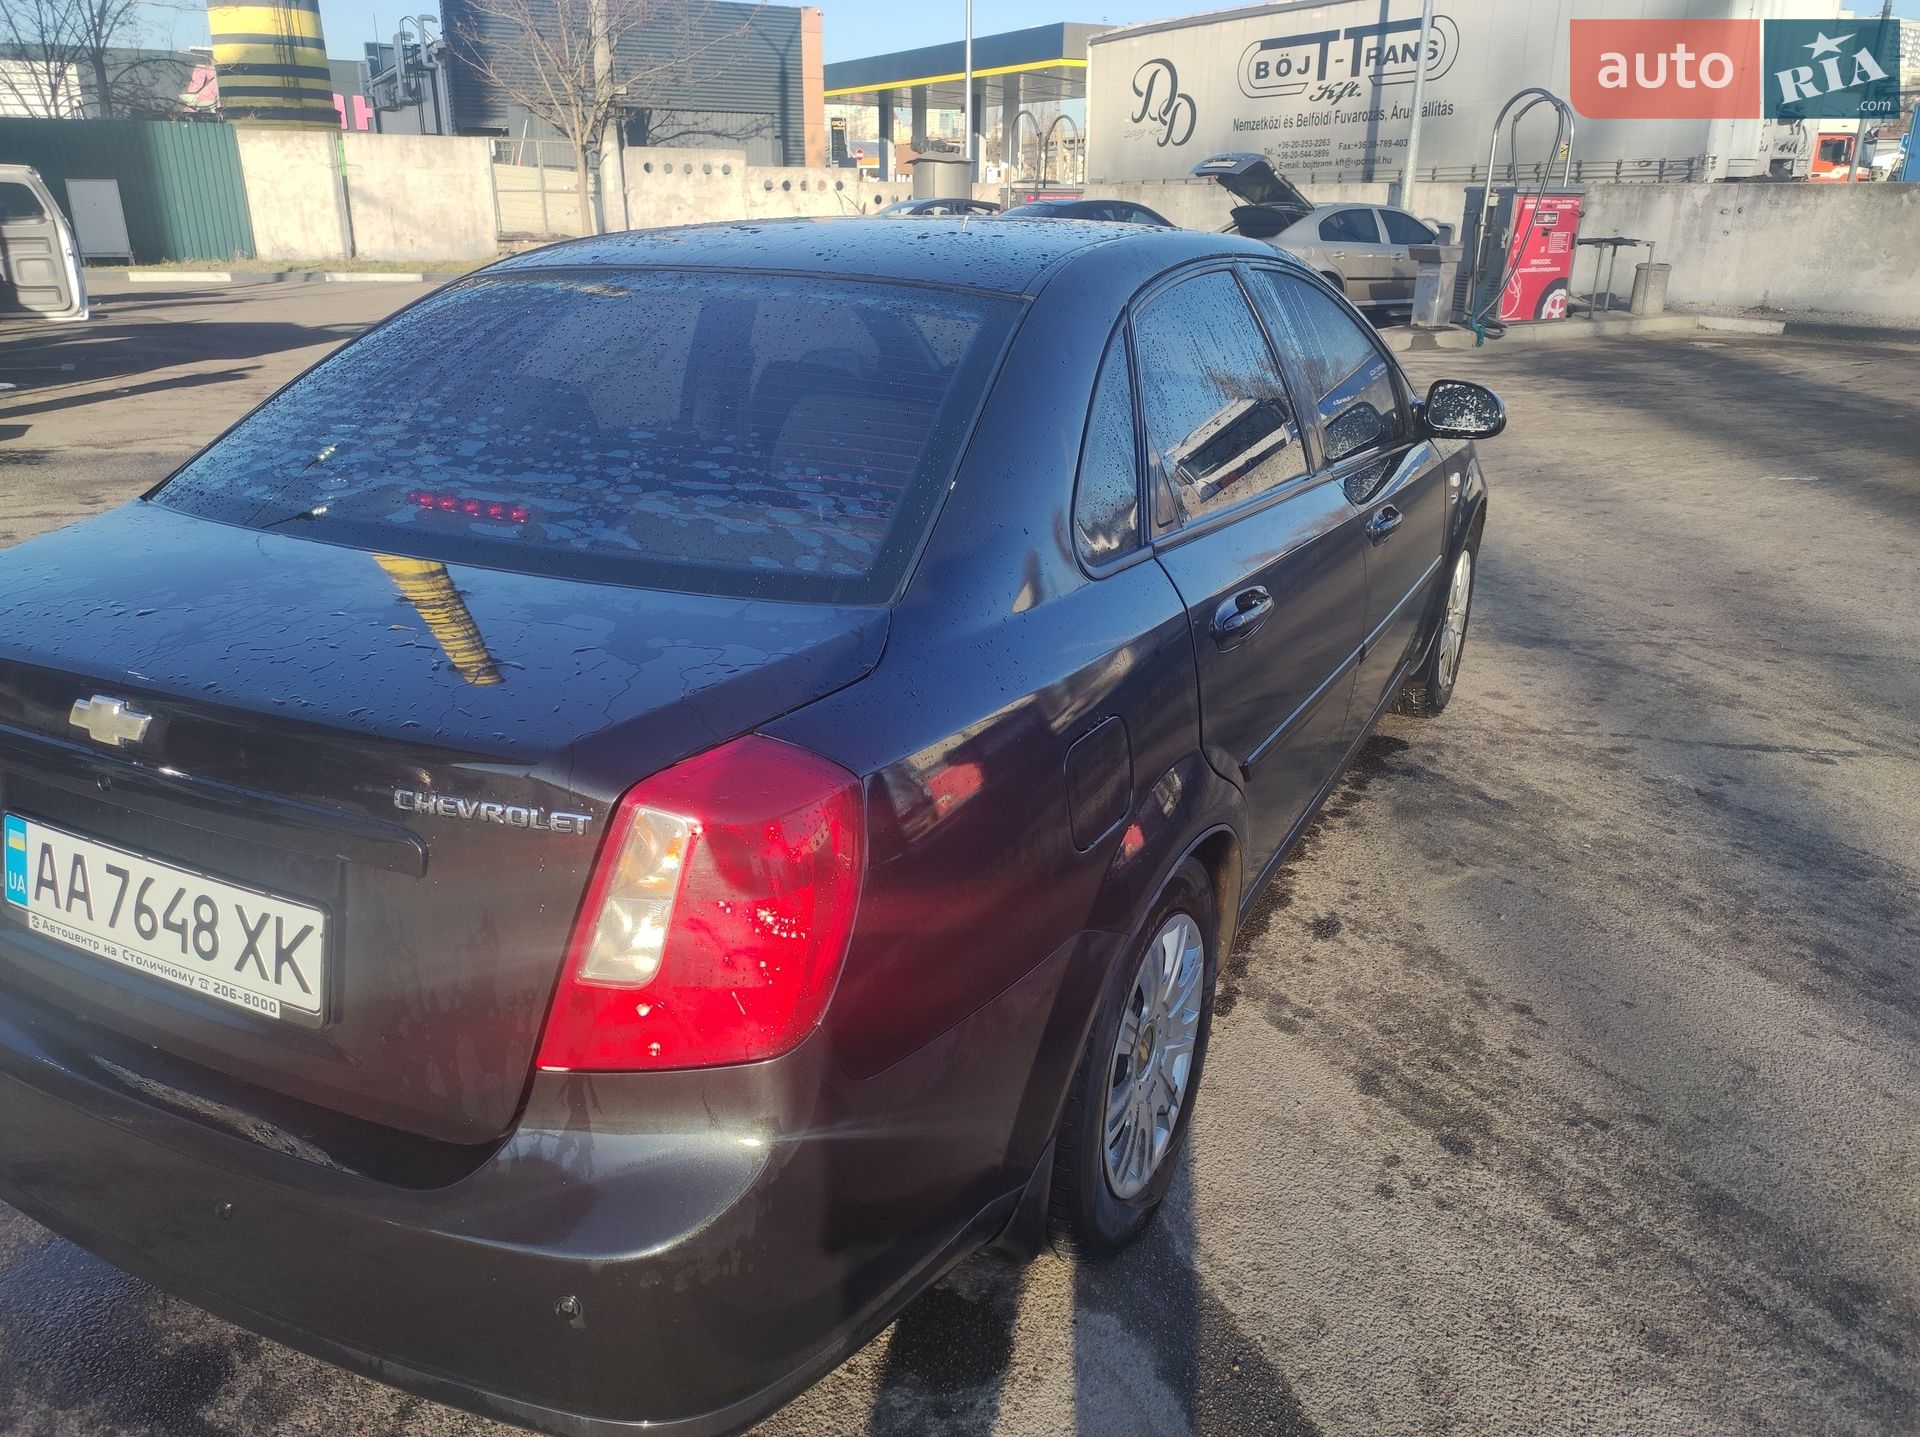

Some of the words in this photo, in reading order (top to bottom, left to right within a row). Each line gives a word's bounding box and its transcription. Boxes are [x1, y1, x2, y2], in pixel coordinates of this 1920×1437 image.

[1308, 81, 1362, 106] Kft.
[1233, 115, 1281, 132] Nemzetközi
[1283, 114, 1294, 129] és
[1296, 111, 1332, 128] Belföldi
[394, 789, 593, 835] CHEVROLET
[9, 871, 26, 894] UA
[42, 919, 100, 951] Автоцентр
[104, 944, 118, 957] на
[122, 949, 195, 986] Столичному
[213, 982, 277, 1014] 206-8000
